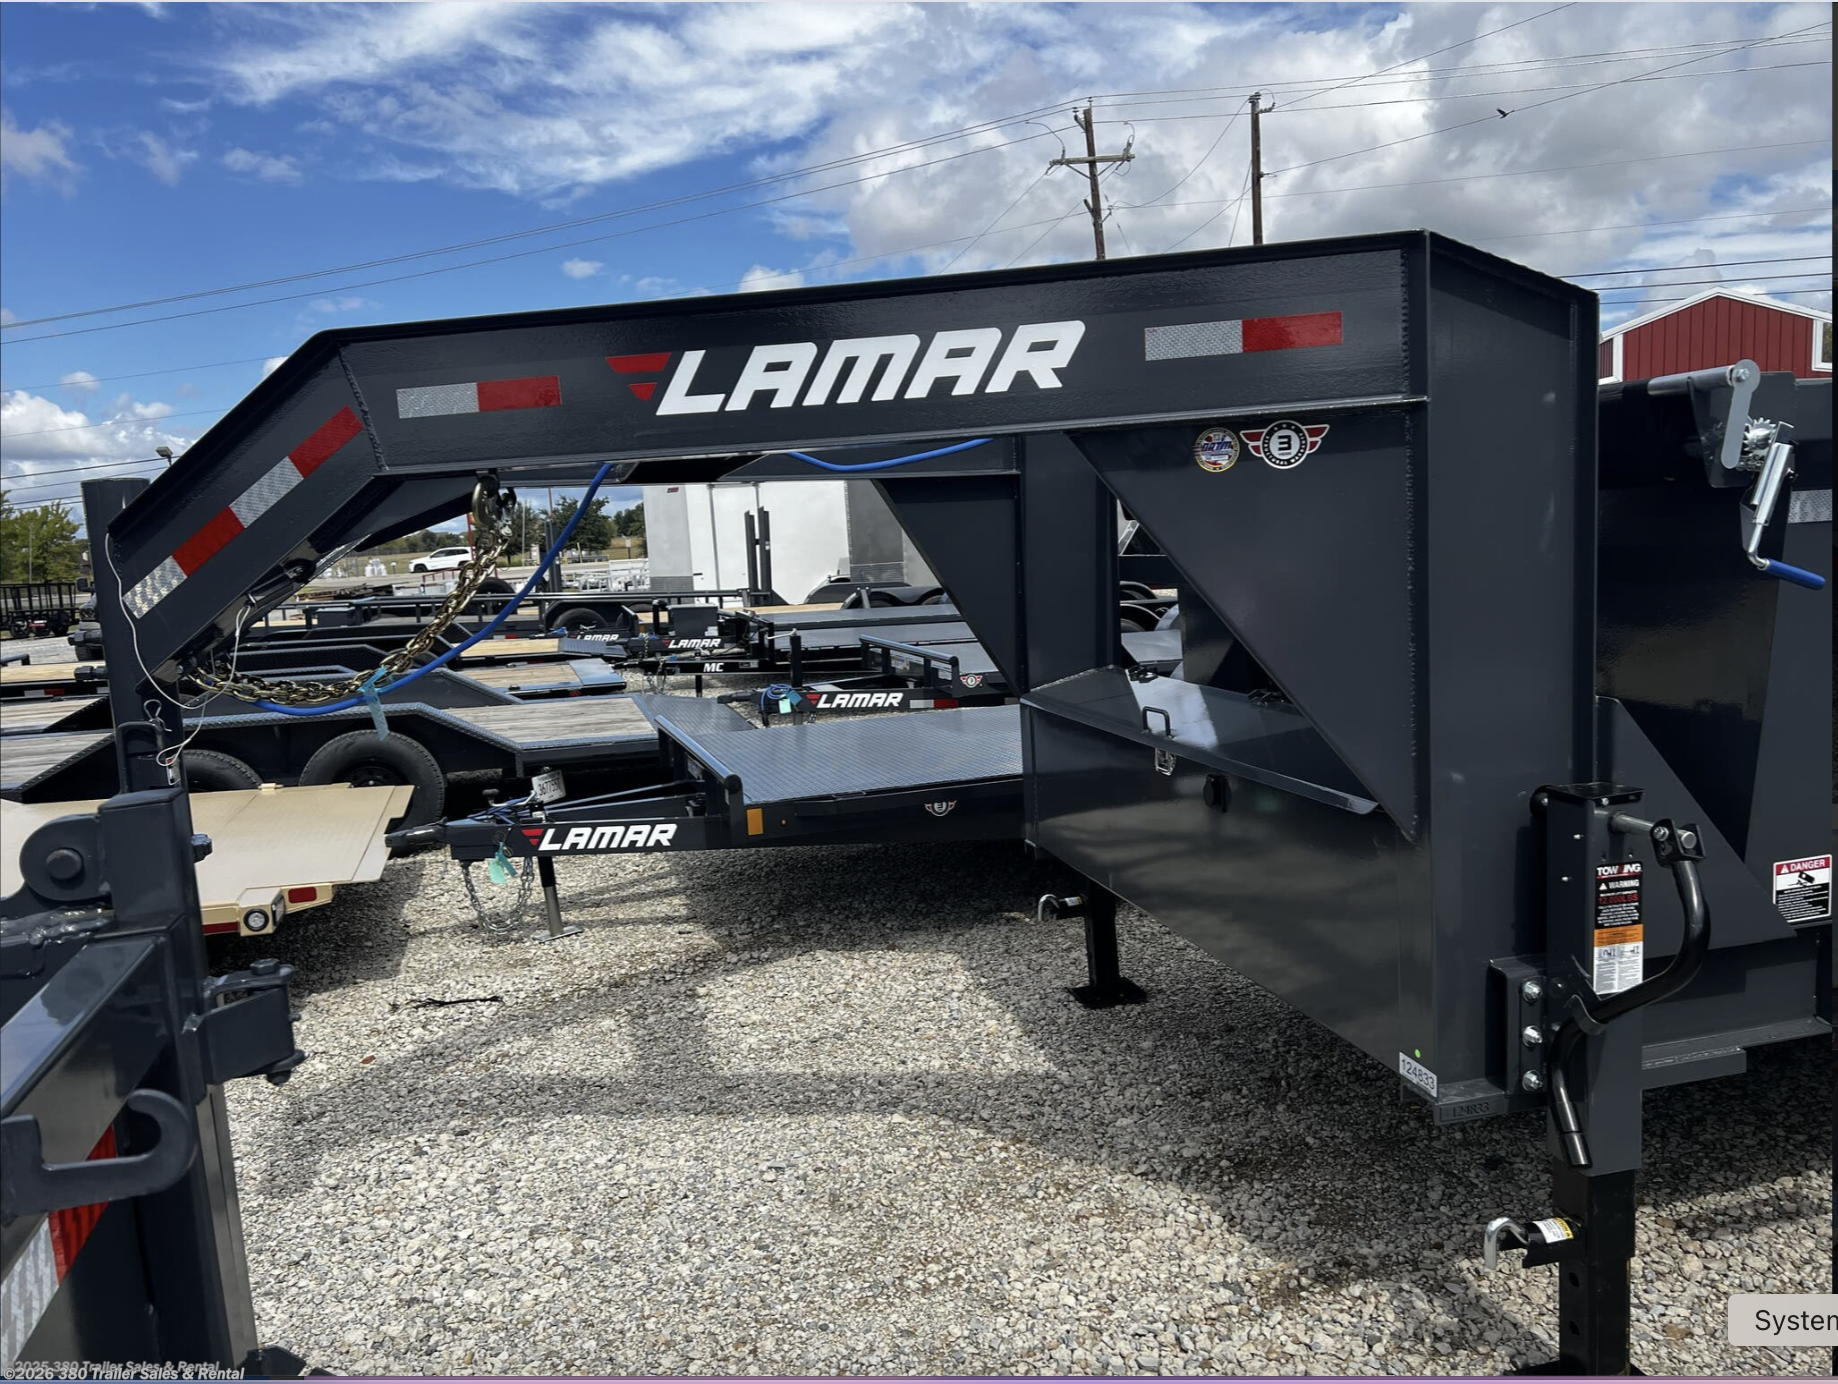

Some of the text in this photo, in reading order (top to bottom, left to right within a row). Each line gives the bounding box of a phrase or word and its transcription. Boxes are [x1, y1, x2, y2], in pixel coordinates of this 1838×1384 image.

[656, 320, 1085, 415] LAMAR
[1278, 434, 1292, 451] 3
[668, 639, 721, 649] LAMAR
[703, 663, 724, 672] MC
[817, 692, 903, 708] LAMAR
[538, 823, 677, 851] LAMAR
[1790, 859, 1826, 872] DANGER
[1609, 879, 1639, 889] WARNING
[1402, 1059, 1435, 1090] 124833
